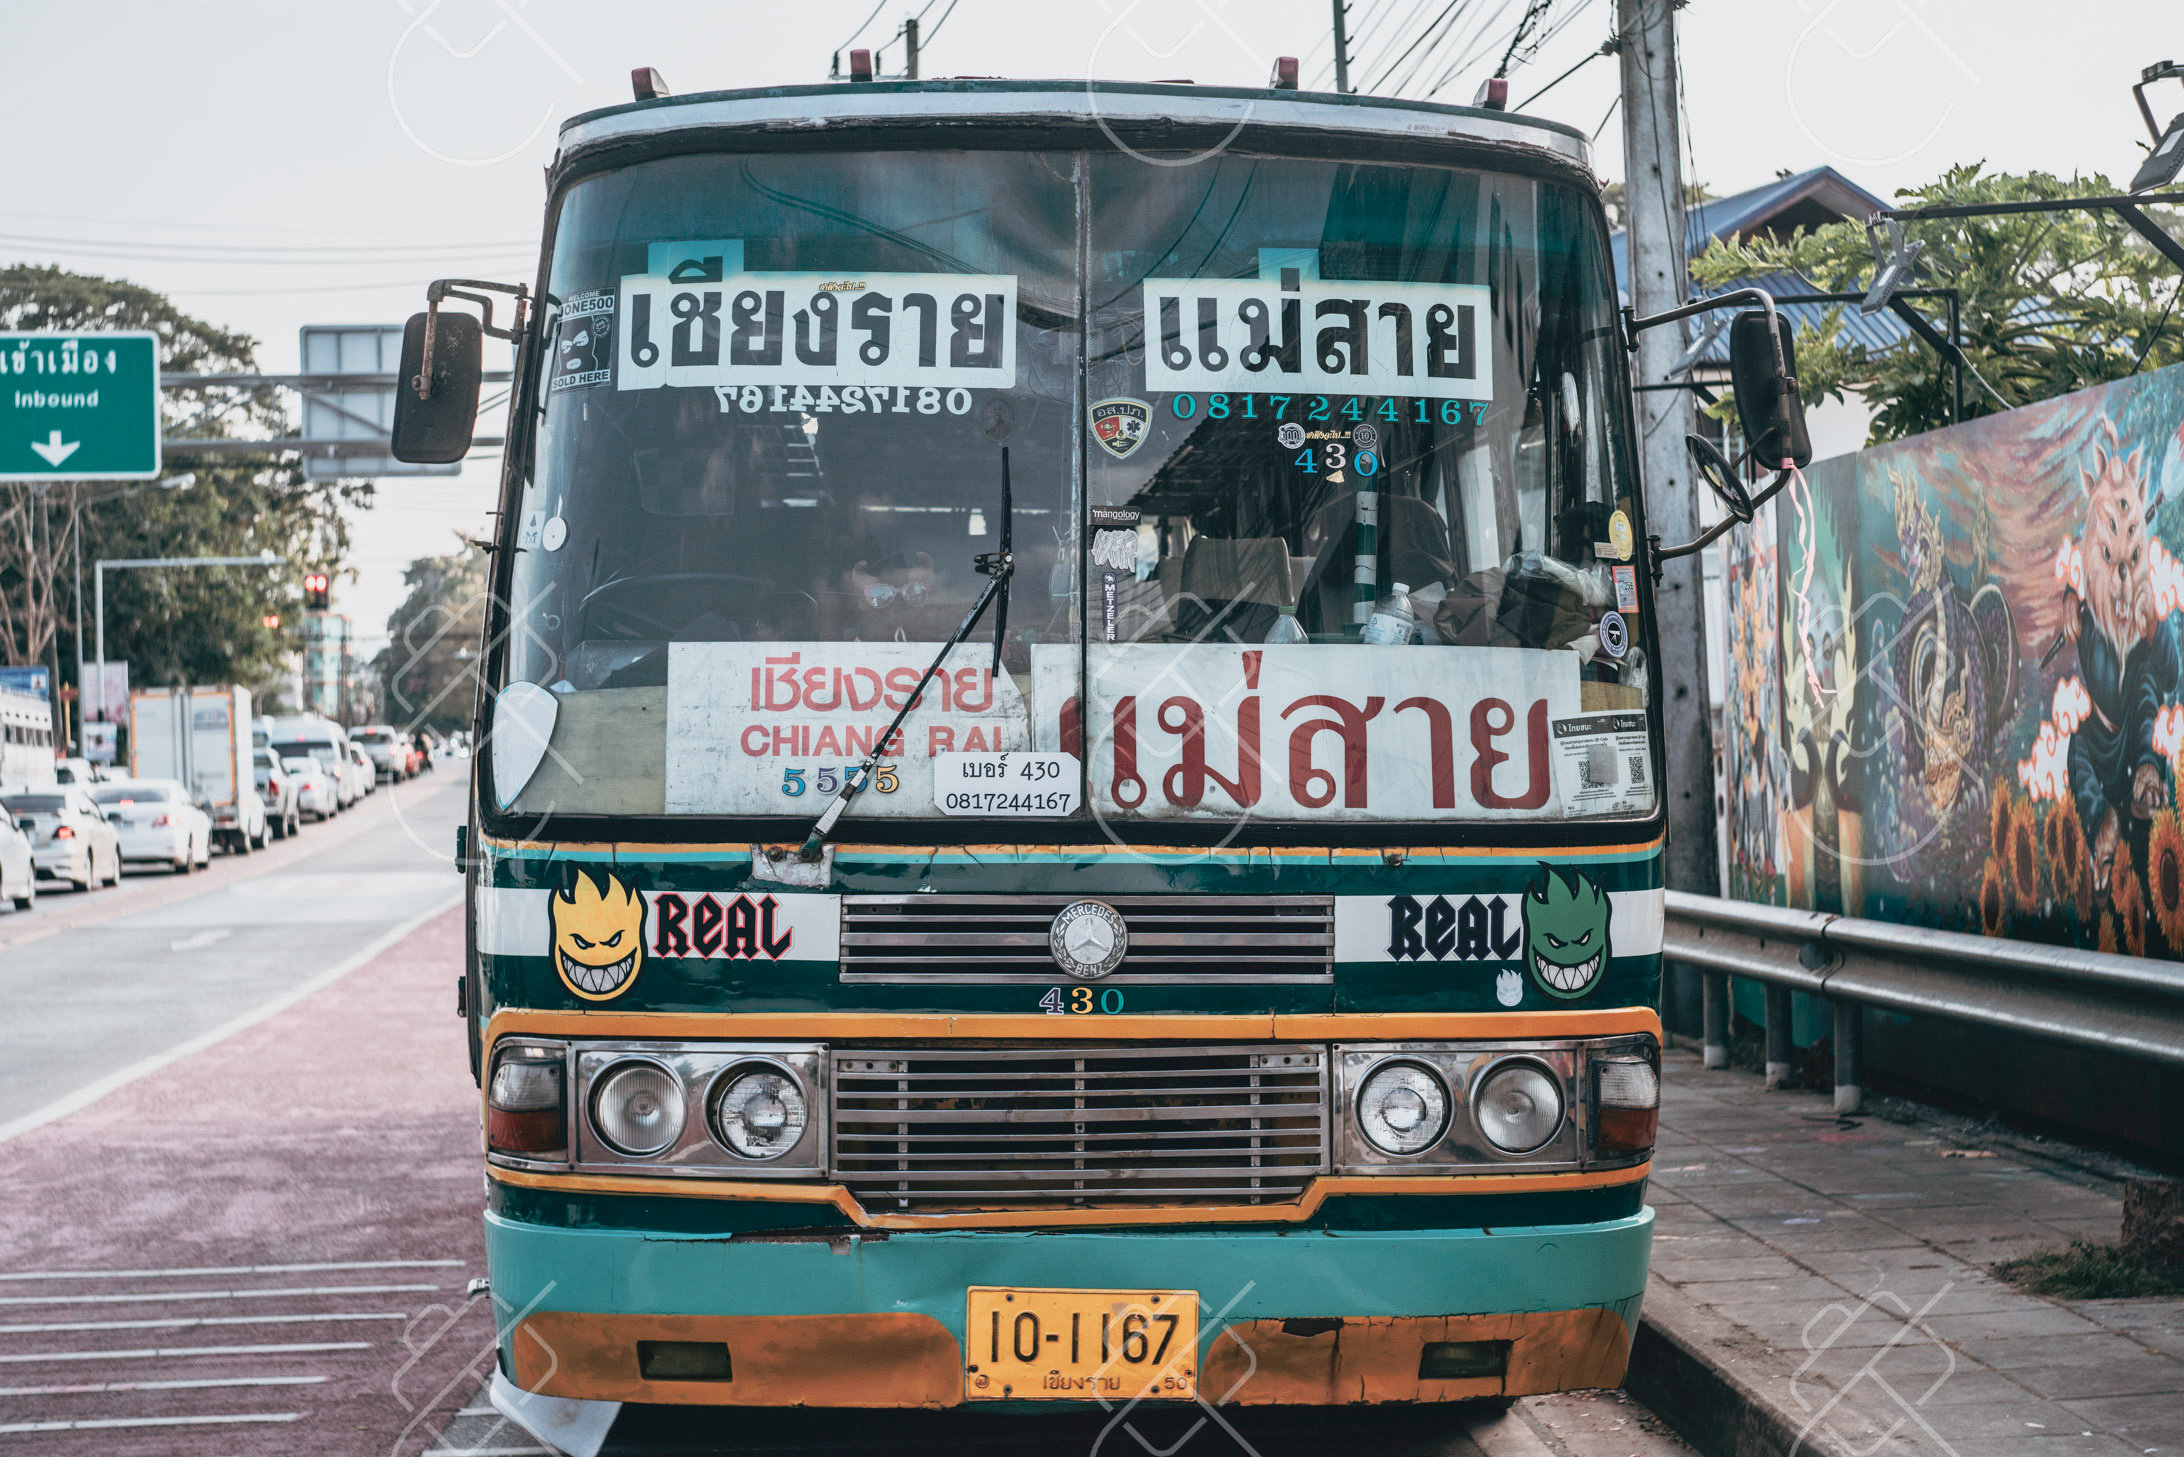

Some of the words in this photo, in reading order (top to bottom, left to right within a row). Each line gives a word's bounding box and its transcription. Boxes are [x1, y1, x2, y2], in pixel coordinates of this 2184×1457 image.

[568, 290, 600, 302] WELCOME
[631, 255, 1005, 369] เชียงราย
[1159, 267, 1477, 380] แม่สาย
[0, 338, 117, 374] เข้าเมือง
[552, 375, 577, 389] SOLD
[579, 370, 609, 383] HERE
[14, 388, 99, 409] Inbound
[1294, 443, 1378, 477] 430
[1092, 509, 1140, 521] mangology
[1104, 583, 1116, 641] METZELER
[750, 651, 996, 713] เชียงราย
[740, 724, 905, 758] CHIANG
[928, 725, 1002, 758] RAI
[962, 752, 1010, 778] เบอร์
[1020, 761, 1061, 782] 430
[945, 791, 1071, 812] 0817244167
[1061, 903, 1118, 924] MERCEDES
[1075, 963, 1105, 976] BENZ
[1038, 986, 1125, 1016] 430
[990, 1310, 1180, 1366] 10-1167
[1042, 1369, 1121, 1391] เชียงราย
[1164, 1376, 1188, 1391] 50
